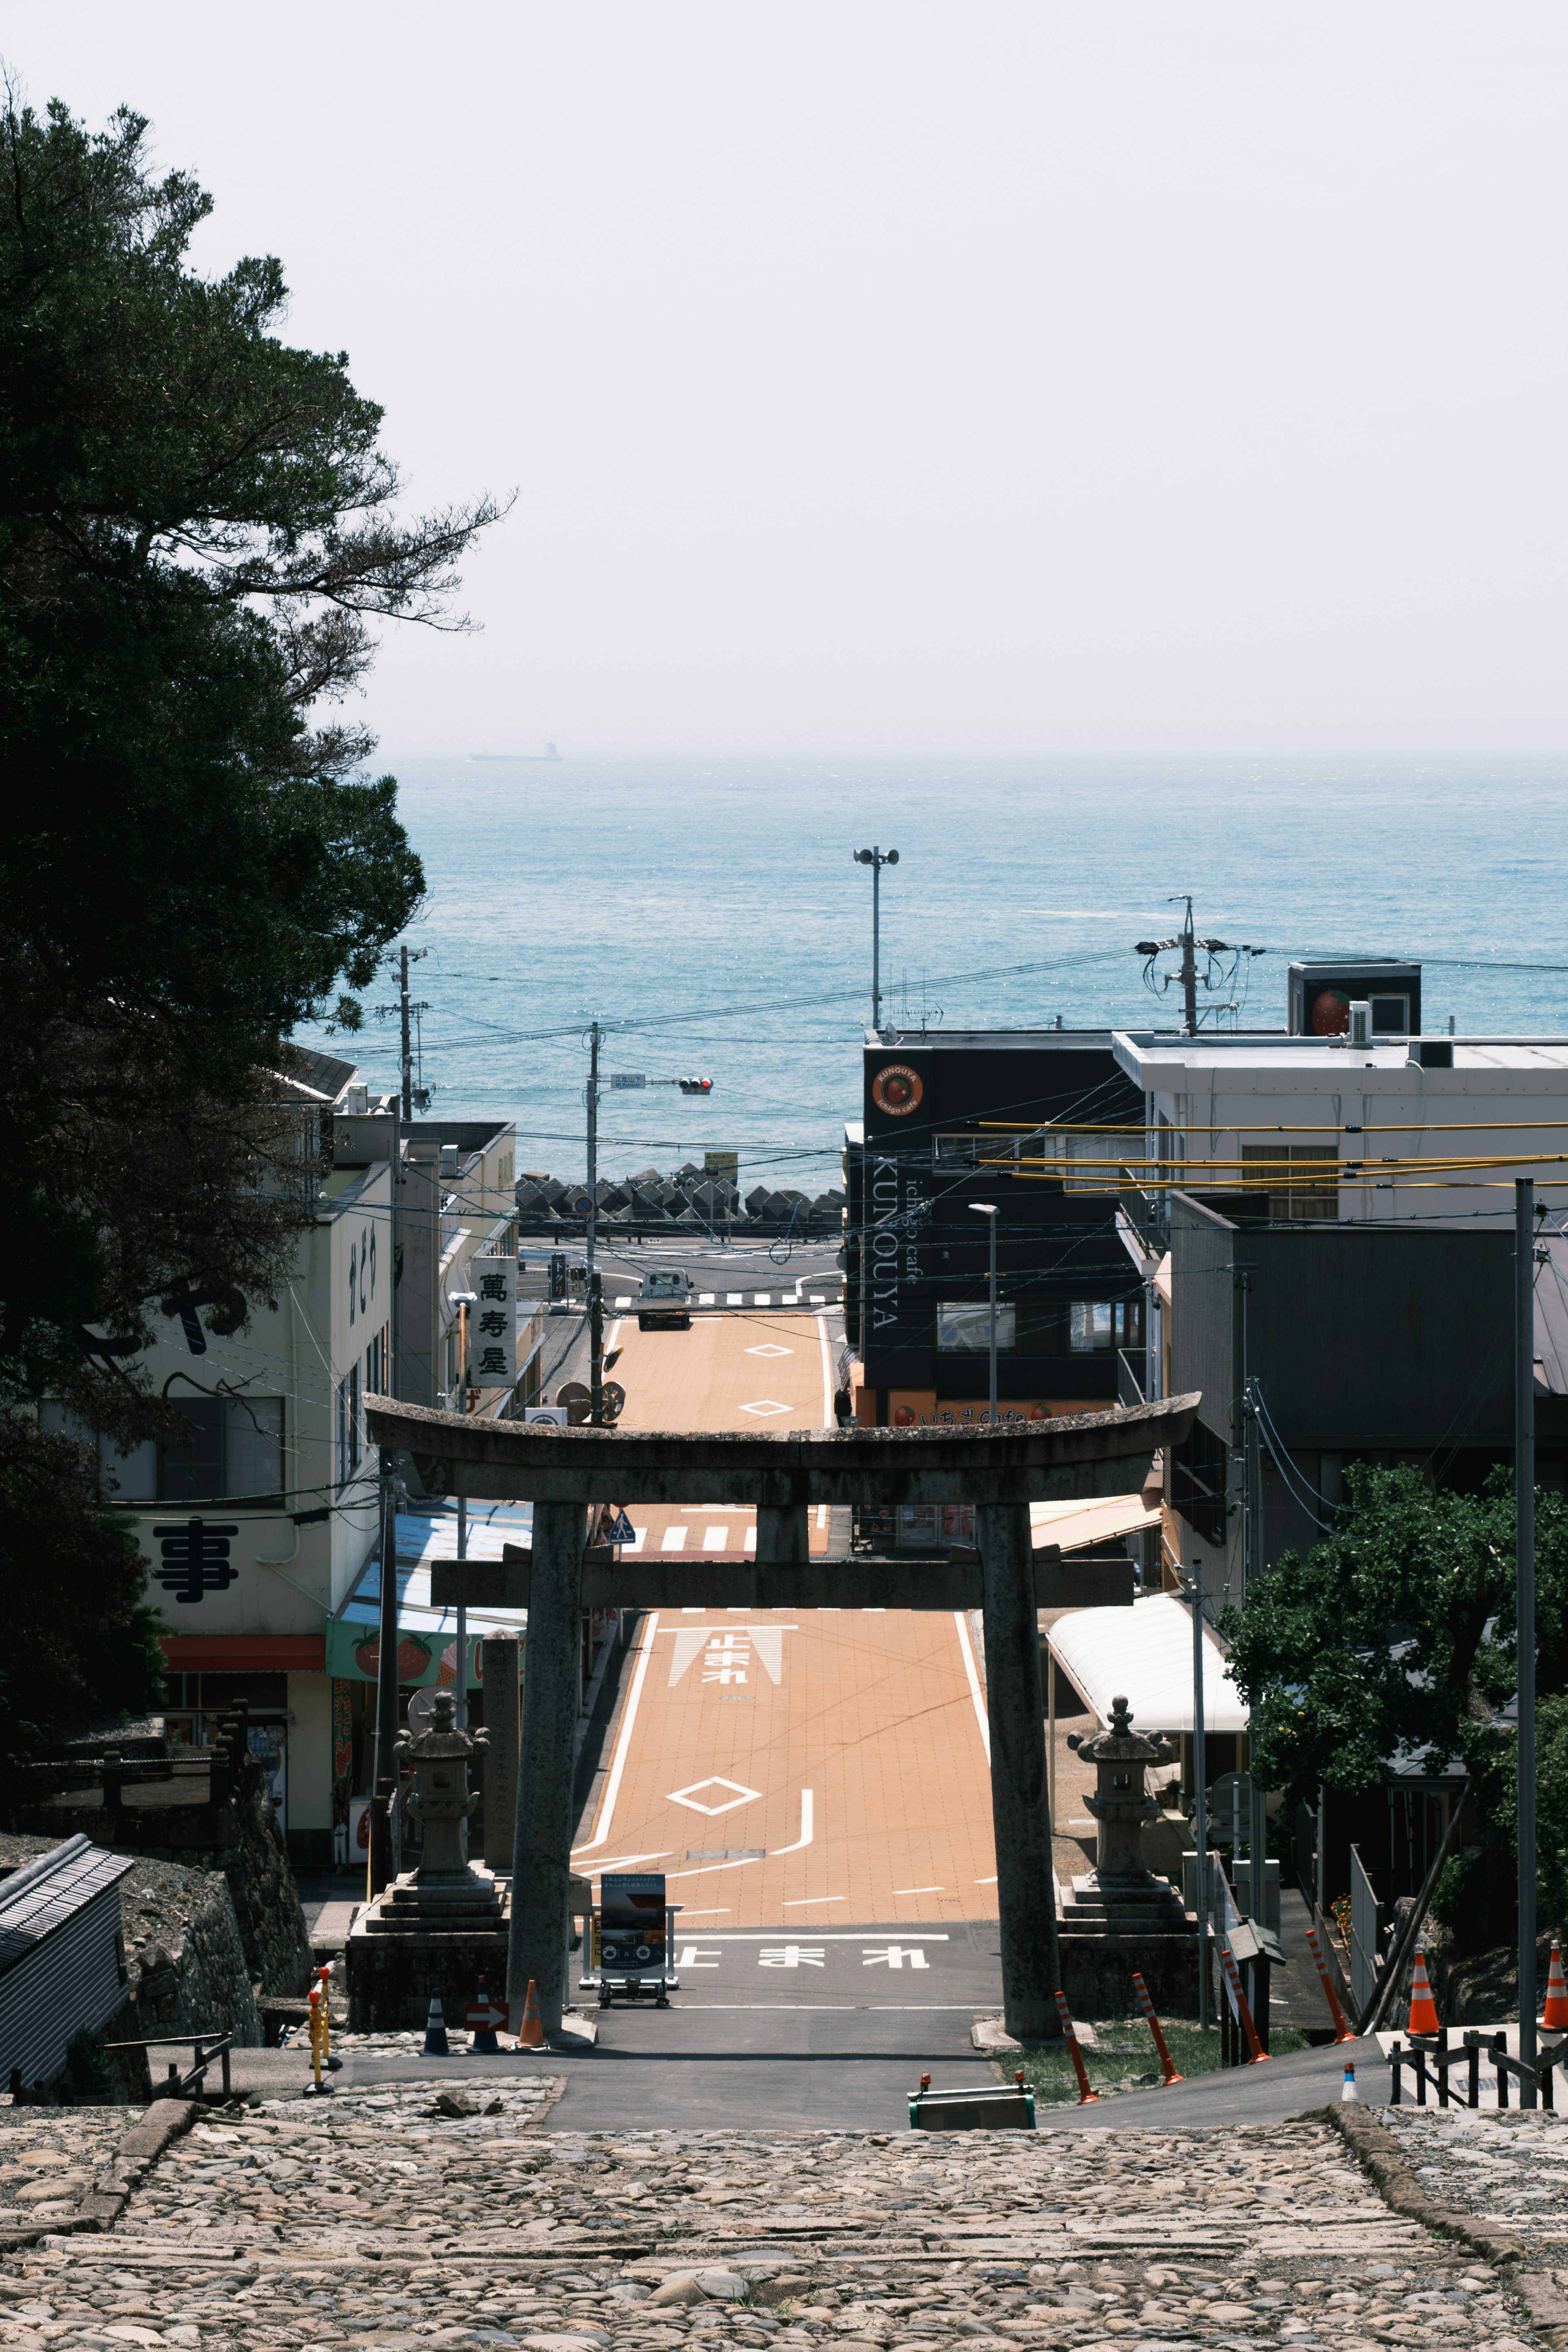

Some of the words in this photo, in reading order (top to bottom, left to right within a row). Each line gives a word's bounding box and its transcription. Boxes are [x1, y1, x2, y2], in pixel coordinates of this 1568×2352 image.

[878, 1067, 916, 1082] KUNOUYA
[878, 1099, 900, 1114] ichigo
[902, 1100, 917, 1112] cafe
[873, 1157, 898, 1330] KUNOUYA
[906, 1246, 923, 1285] cafe
[478, 1273, 508, 1375] 萬寿屋
[702, 1634, 750, 1684] 止まれ
[667, 1946, 930, 1968] 止まれ
